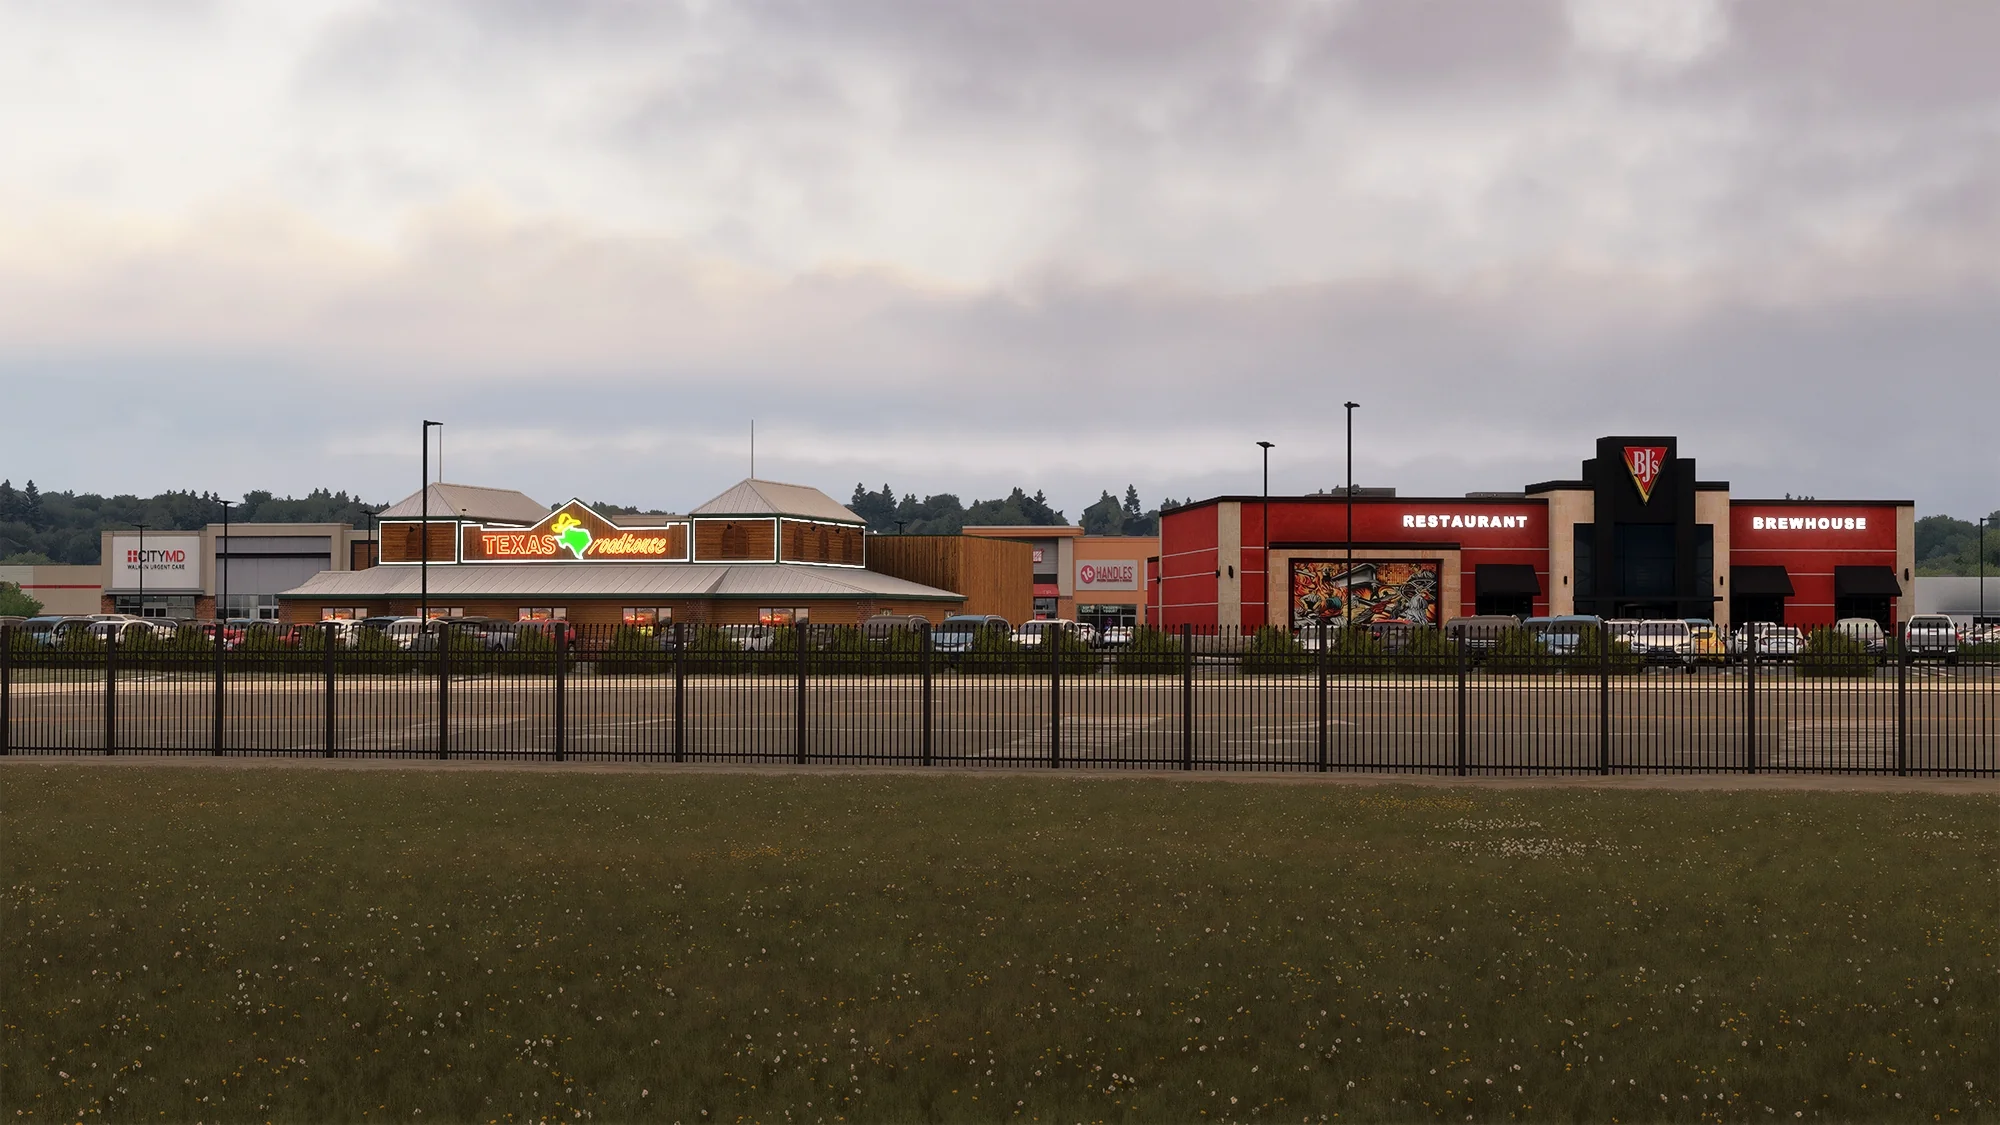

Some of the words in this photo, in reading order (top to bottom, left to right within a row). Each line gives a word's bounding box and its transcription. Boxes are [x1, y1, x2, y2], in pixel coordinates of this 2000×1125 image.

[633, 449, 659, 482] BJ's
[1403, 515, 1528, 528] RESTAURANT
[1753, 516, 1866, 530] BREWHOUSE
[482, 534, 556, 554] TEXAS
[588, 533, 666, 555] roadhouse
[138, 550, 185, 562] CITYMD
[1081, 567, 1094, 581] 16
[1096, 566, 1133, 579] HANDLES
